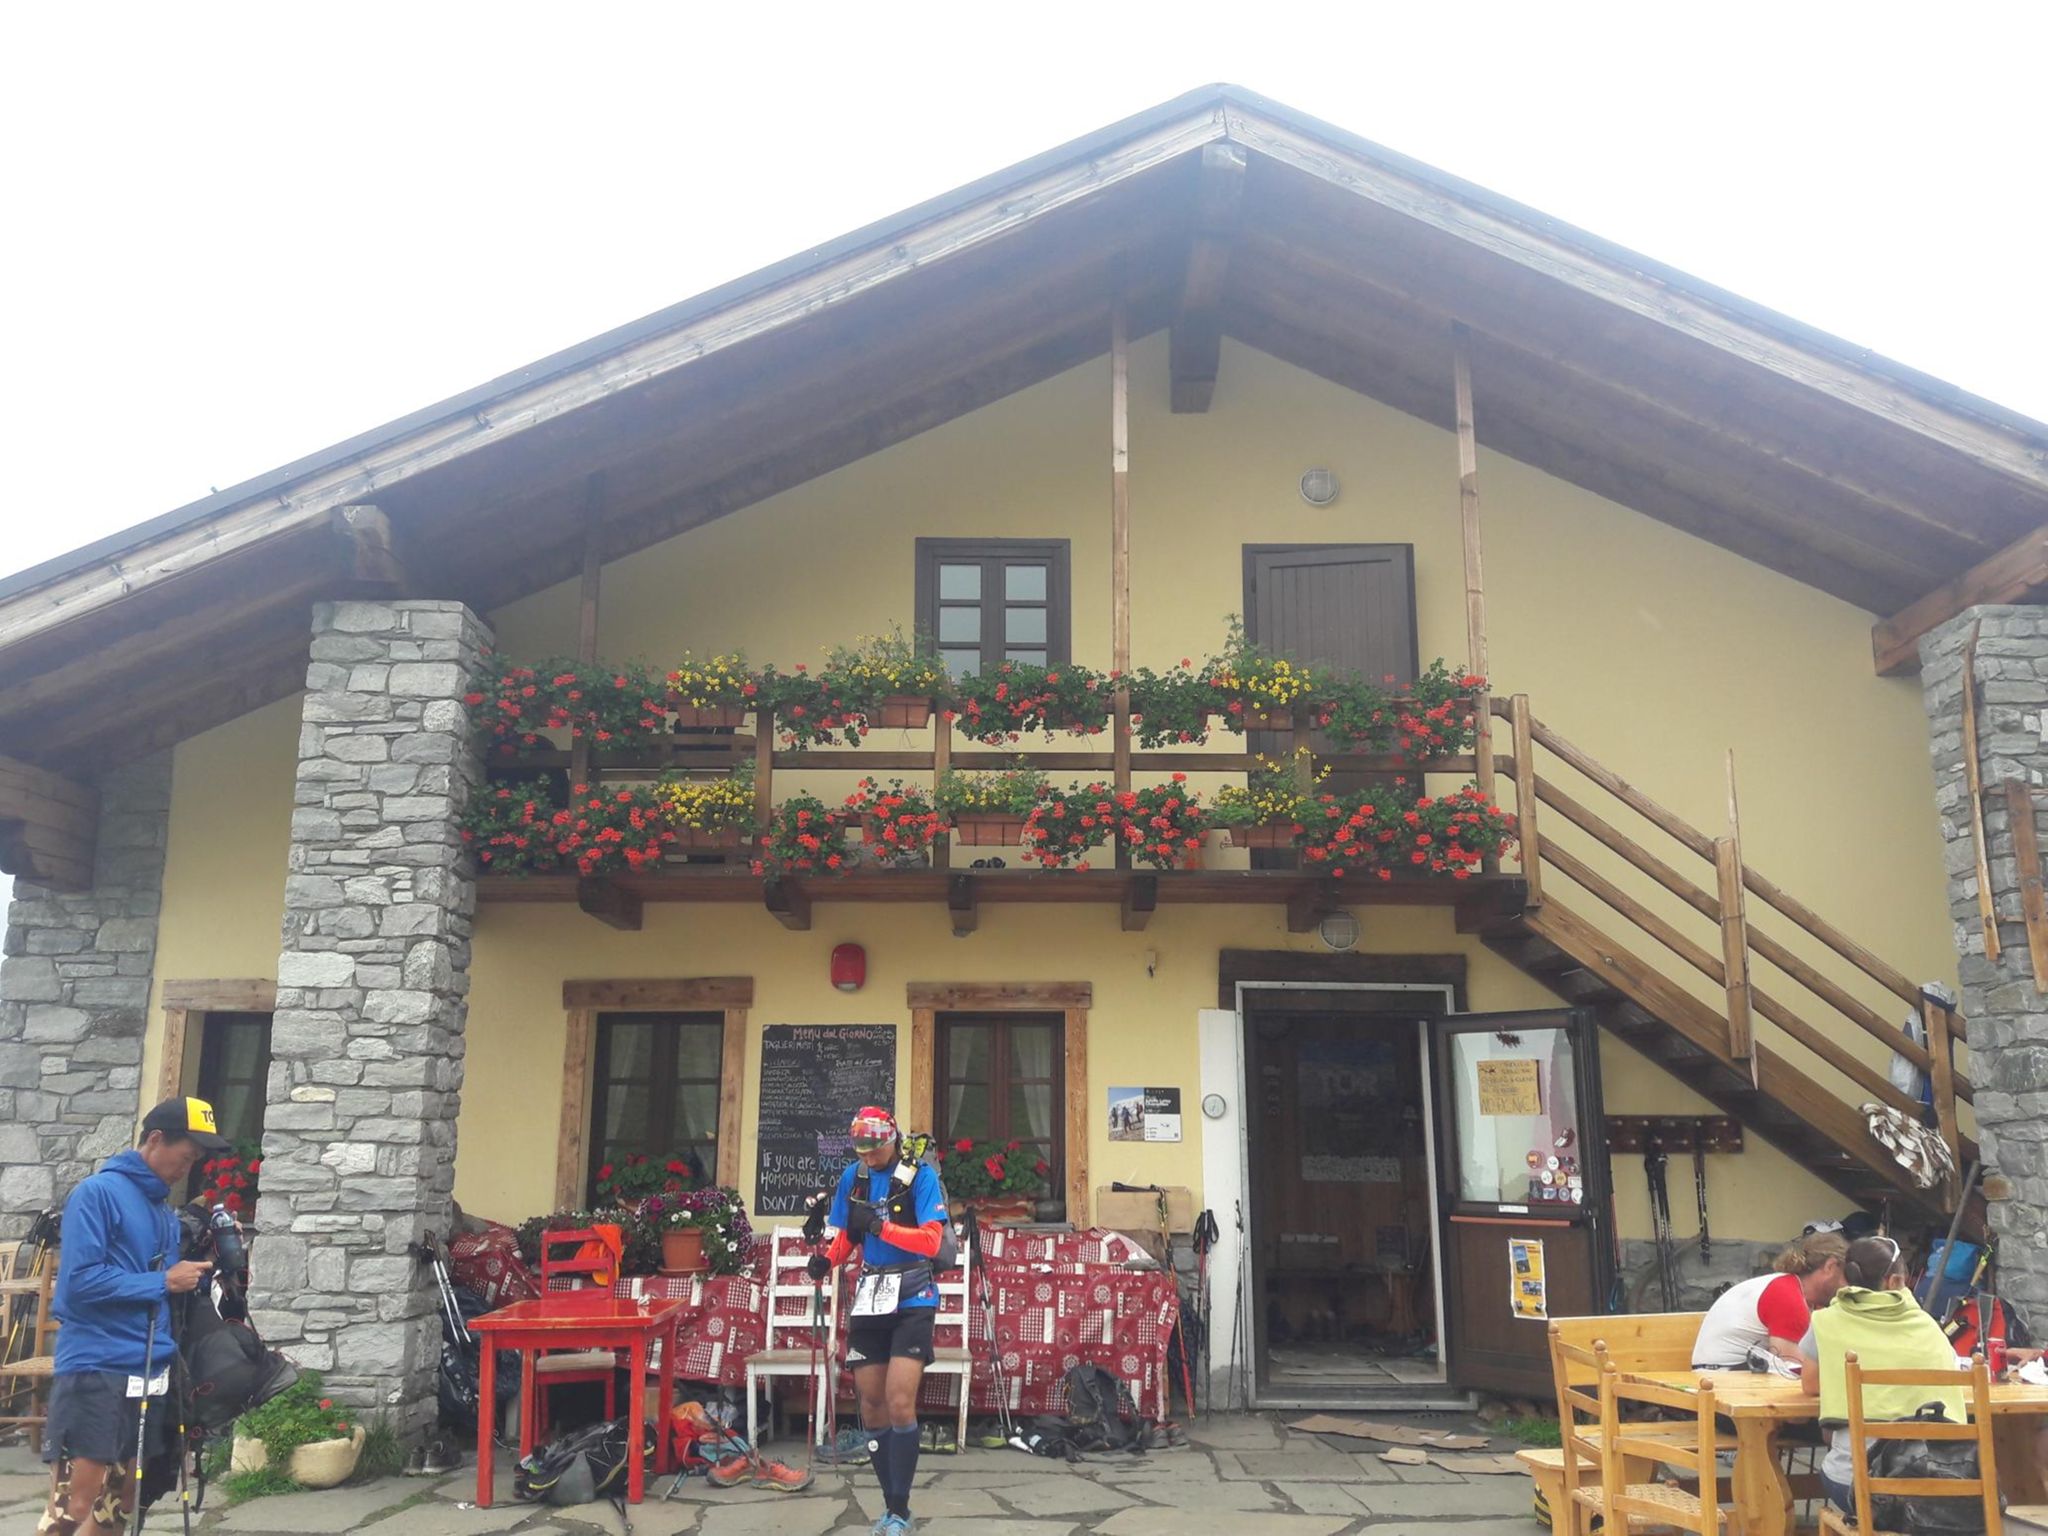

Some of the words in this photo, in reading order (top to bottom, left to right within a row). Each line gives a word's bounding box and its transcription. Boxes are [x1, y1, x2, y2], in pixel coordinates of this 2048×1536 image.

[773, 1155, 795, 1172] you
[797, 1156, 816, 1170] are
[762, 1195, 799, 1211] DON'T
